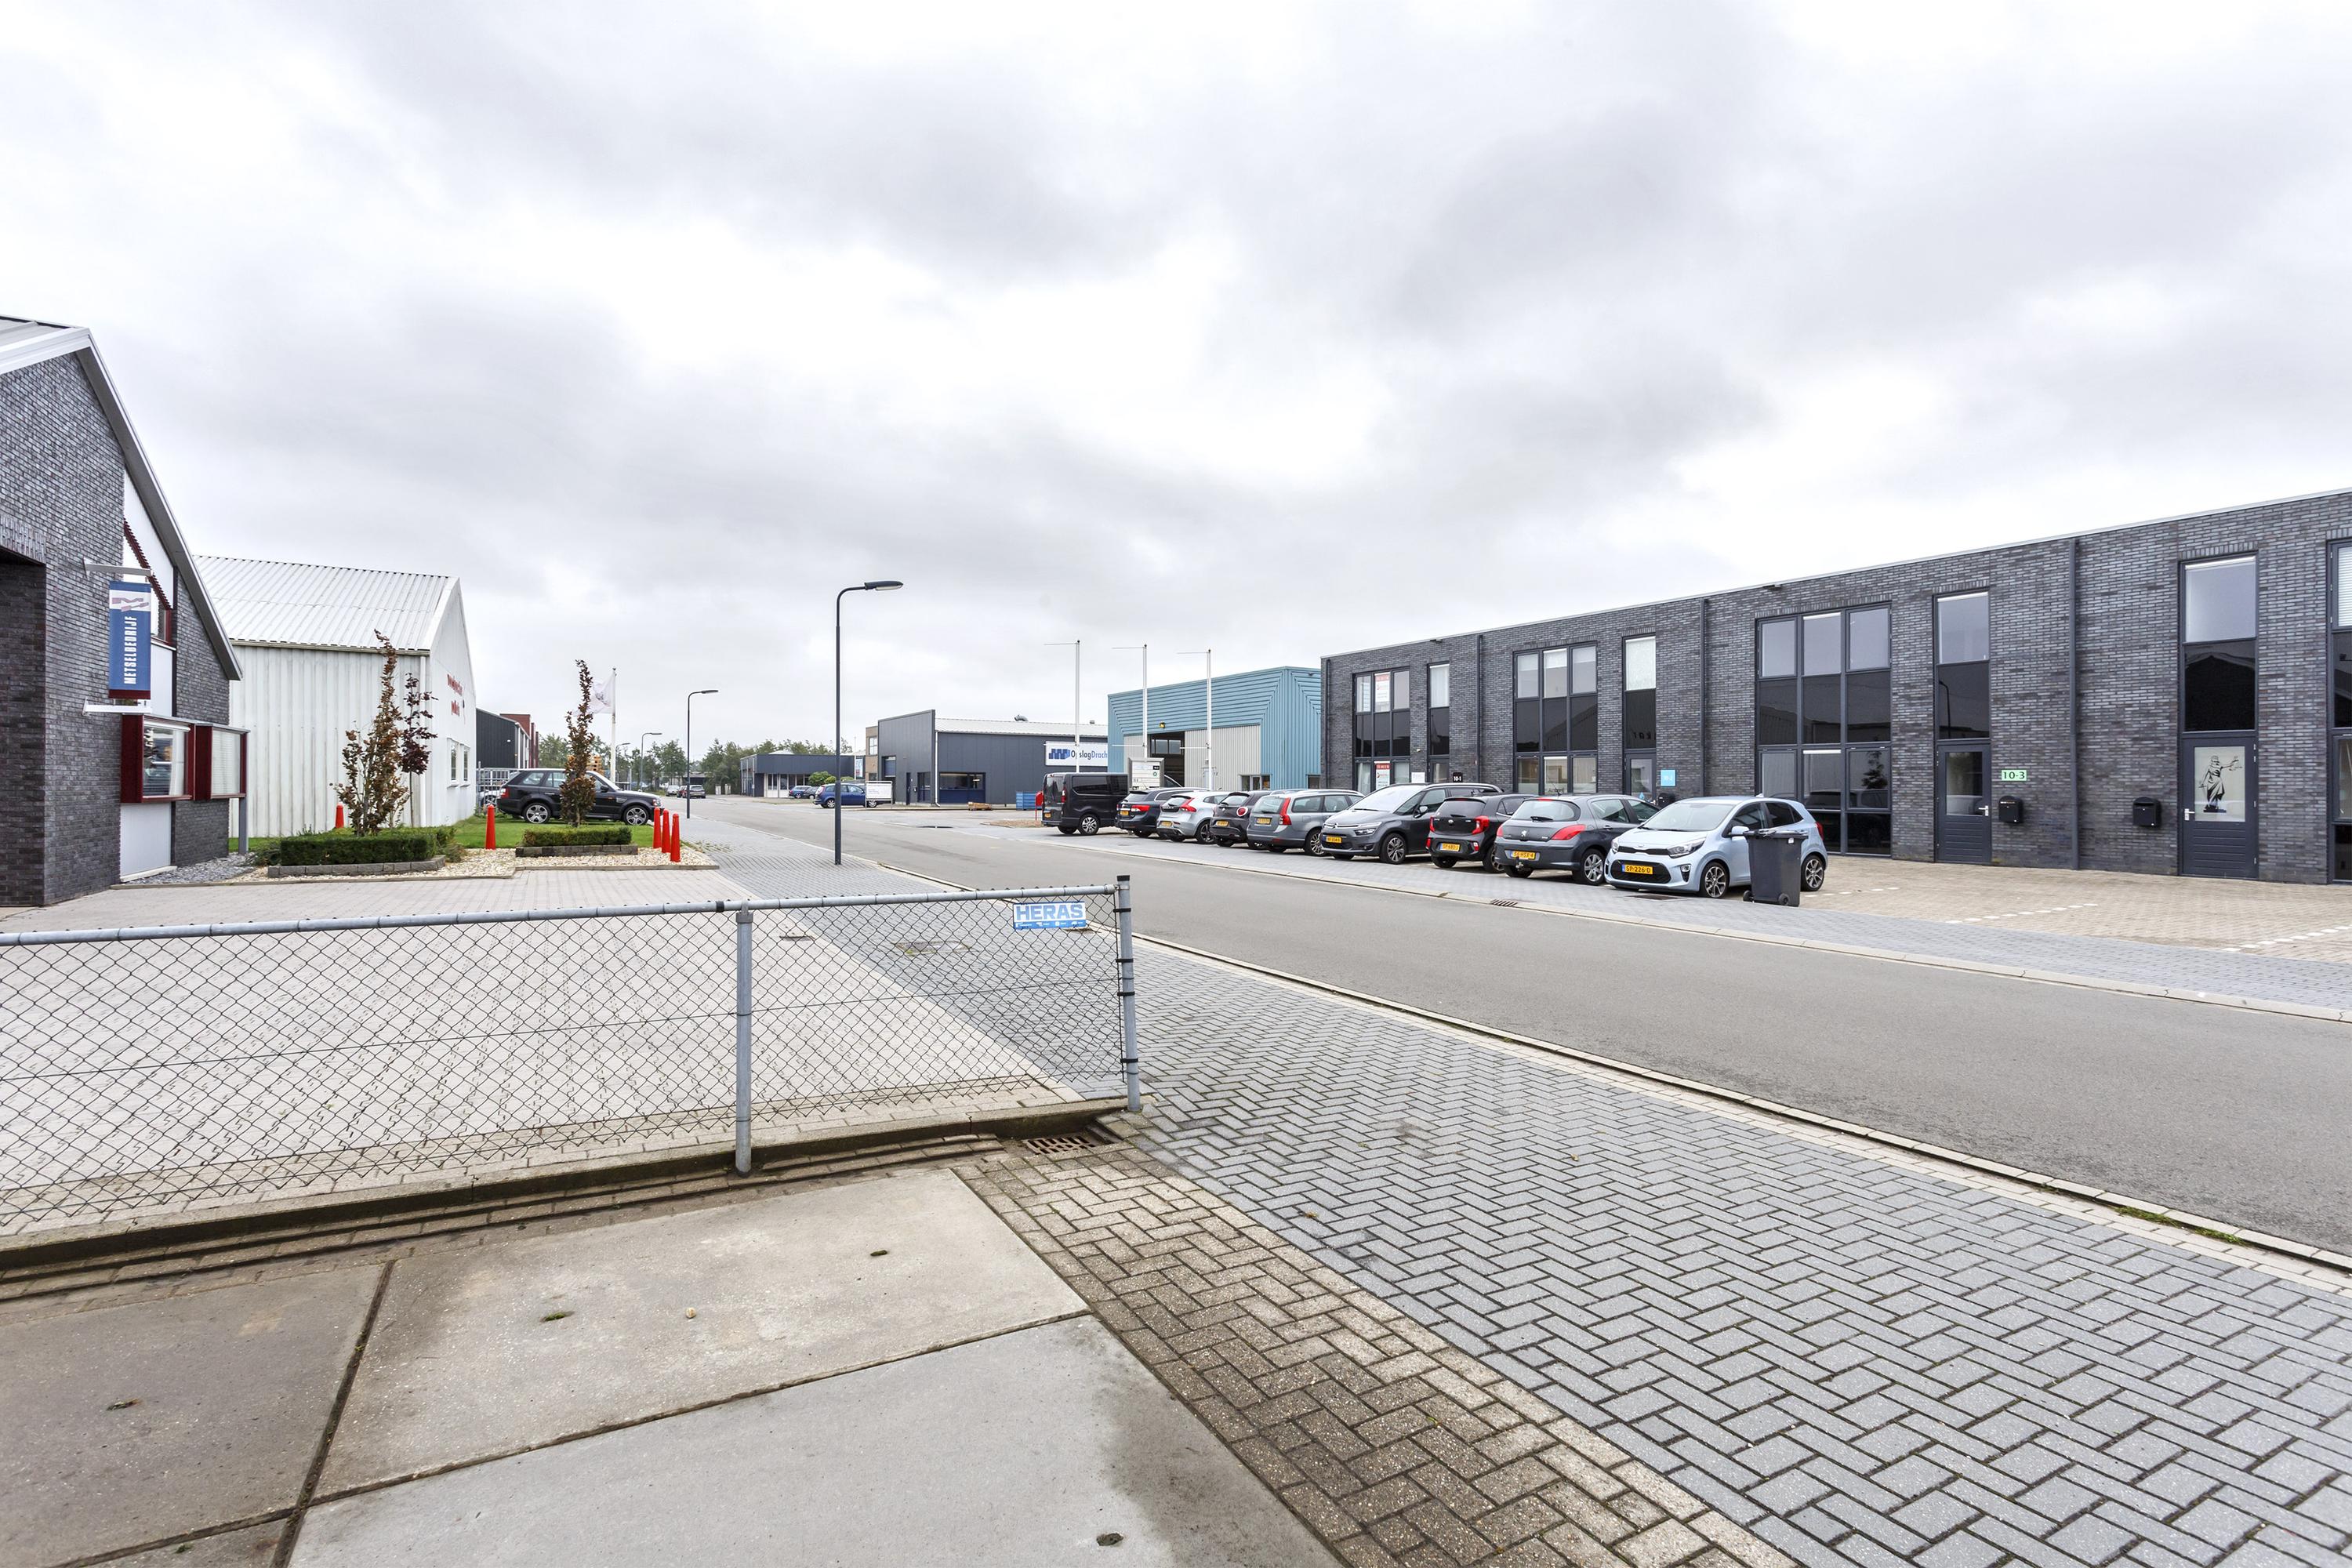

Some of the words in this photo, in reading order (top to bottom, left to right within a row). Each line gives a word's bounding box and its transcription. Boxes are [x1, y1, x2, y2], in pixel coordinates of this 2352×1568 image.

[124, 615, 137, 684] METSELBEDRIJF
[1071, 750, 1108, 760] OslagDrach
[2003, 771, 2025, 779] 10-3
[1625, 865, 1651, 873] SP-226-D
[1016, 904, 1083, 920] HERAS
